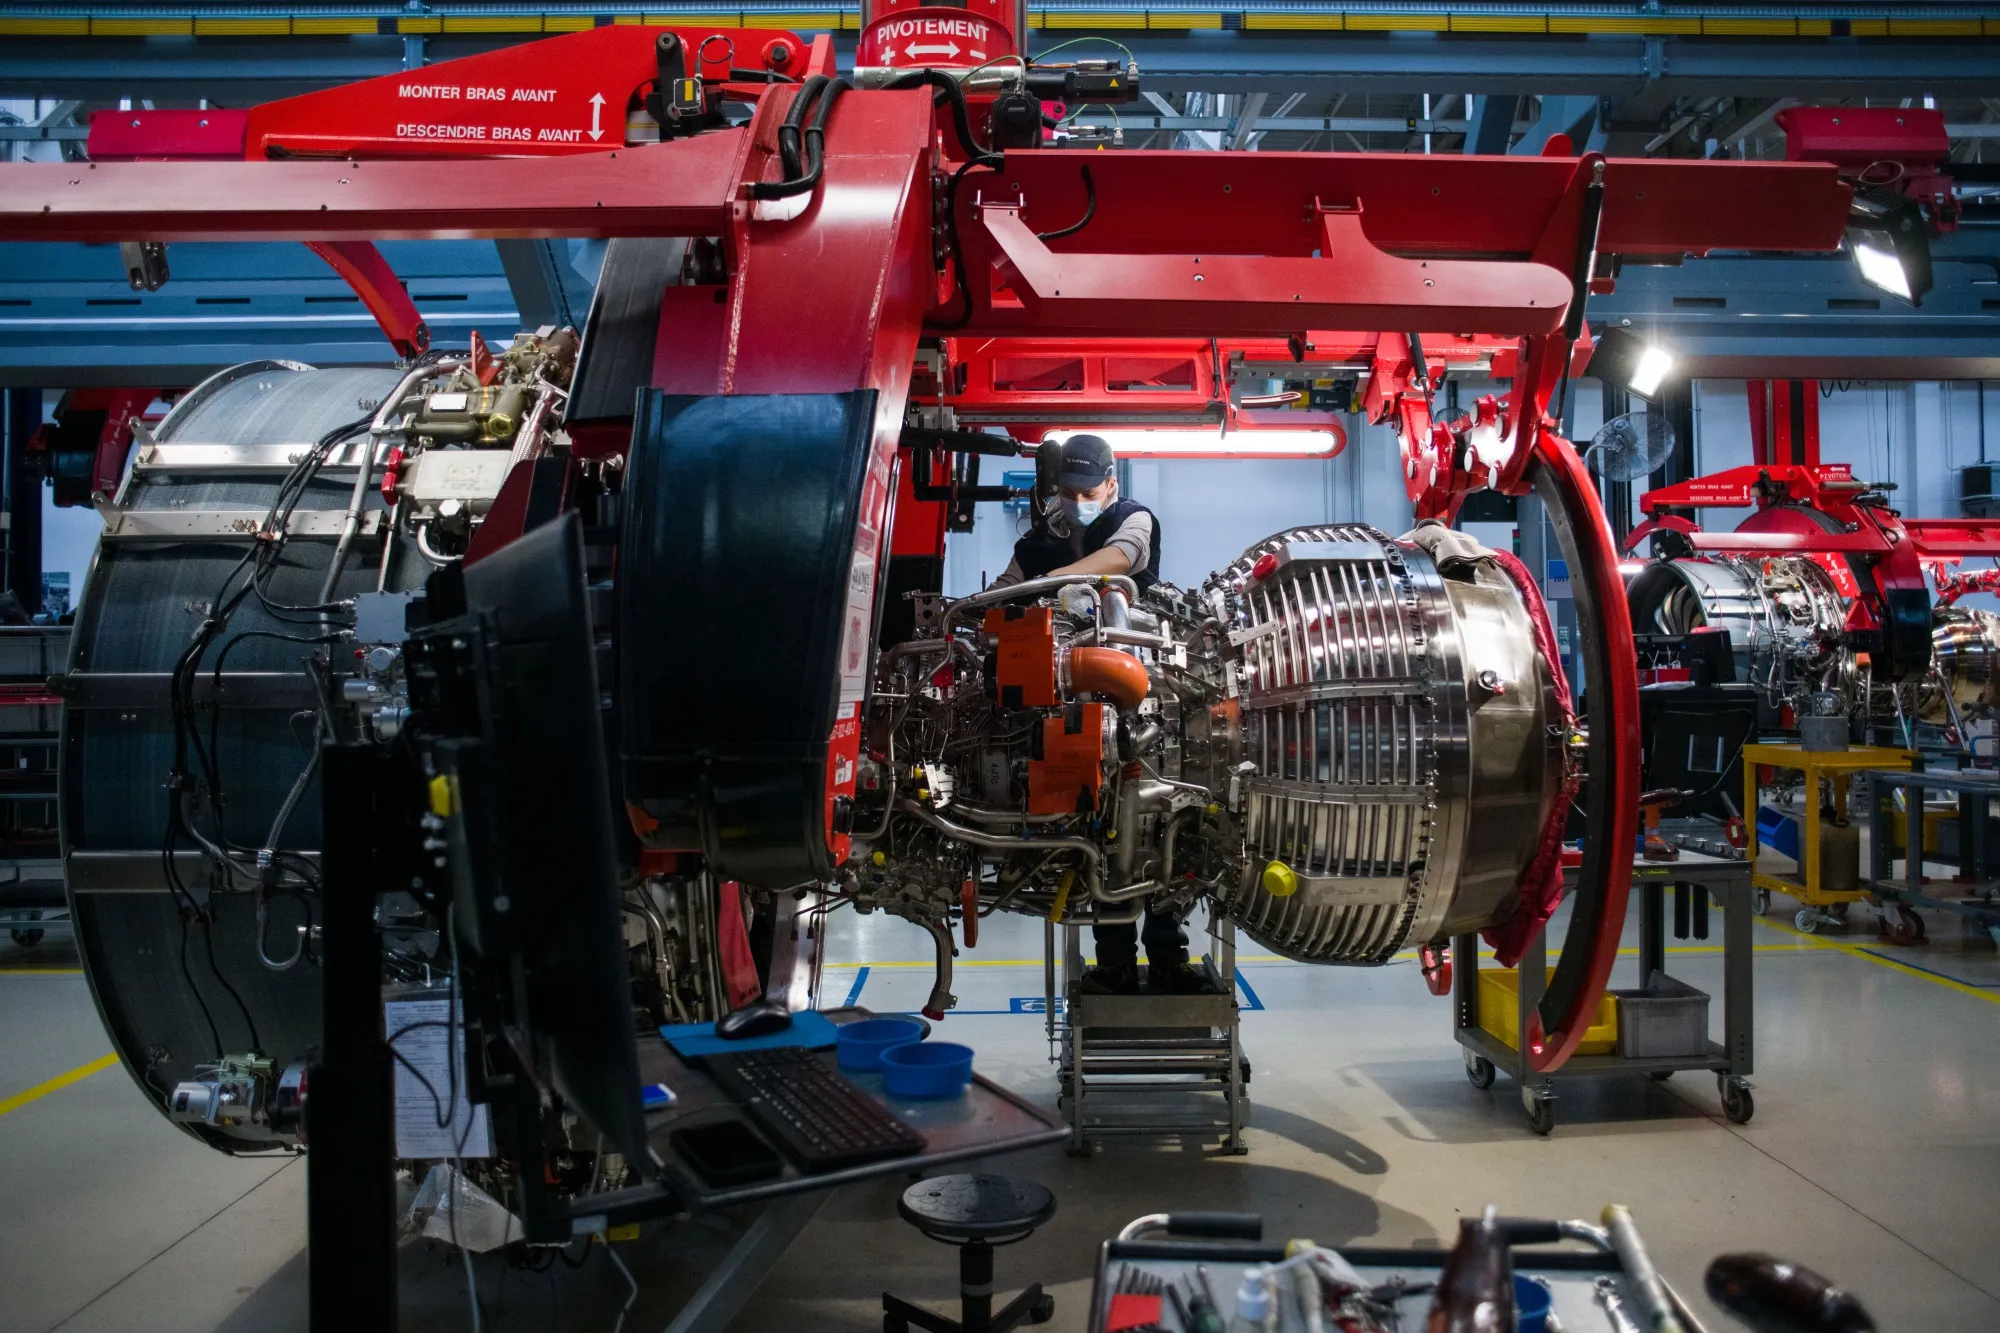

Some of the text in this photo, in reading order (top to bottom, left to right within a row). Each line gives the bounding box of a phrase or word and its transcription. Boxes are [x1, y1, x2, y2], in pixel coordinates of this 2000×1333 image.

[877, 19, 989, 44] PIVOTEMENT
[399, 85, 557, 103] MONTER BRAS AVANT
[396, 124, 582, 142] DESCENDRE BRAS AVANT
